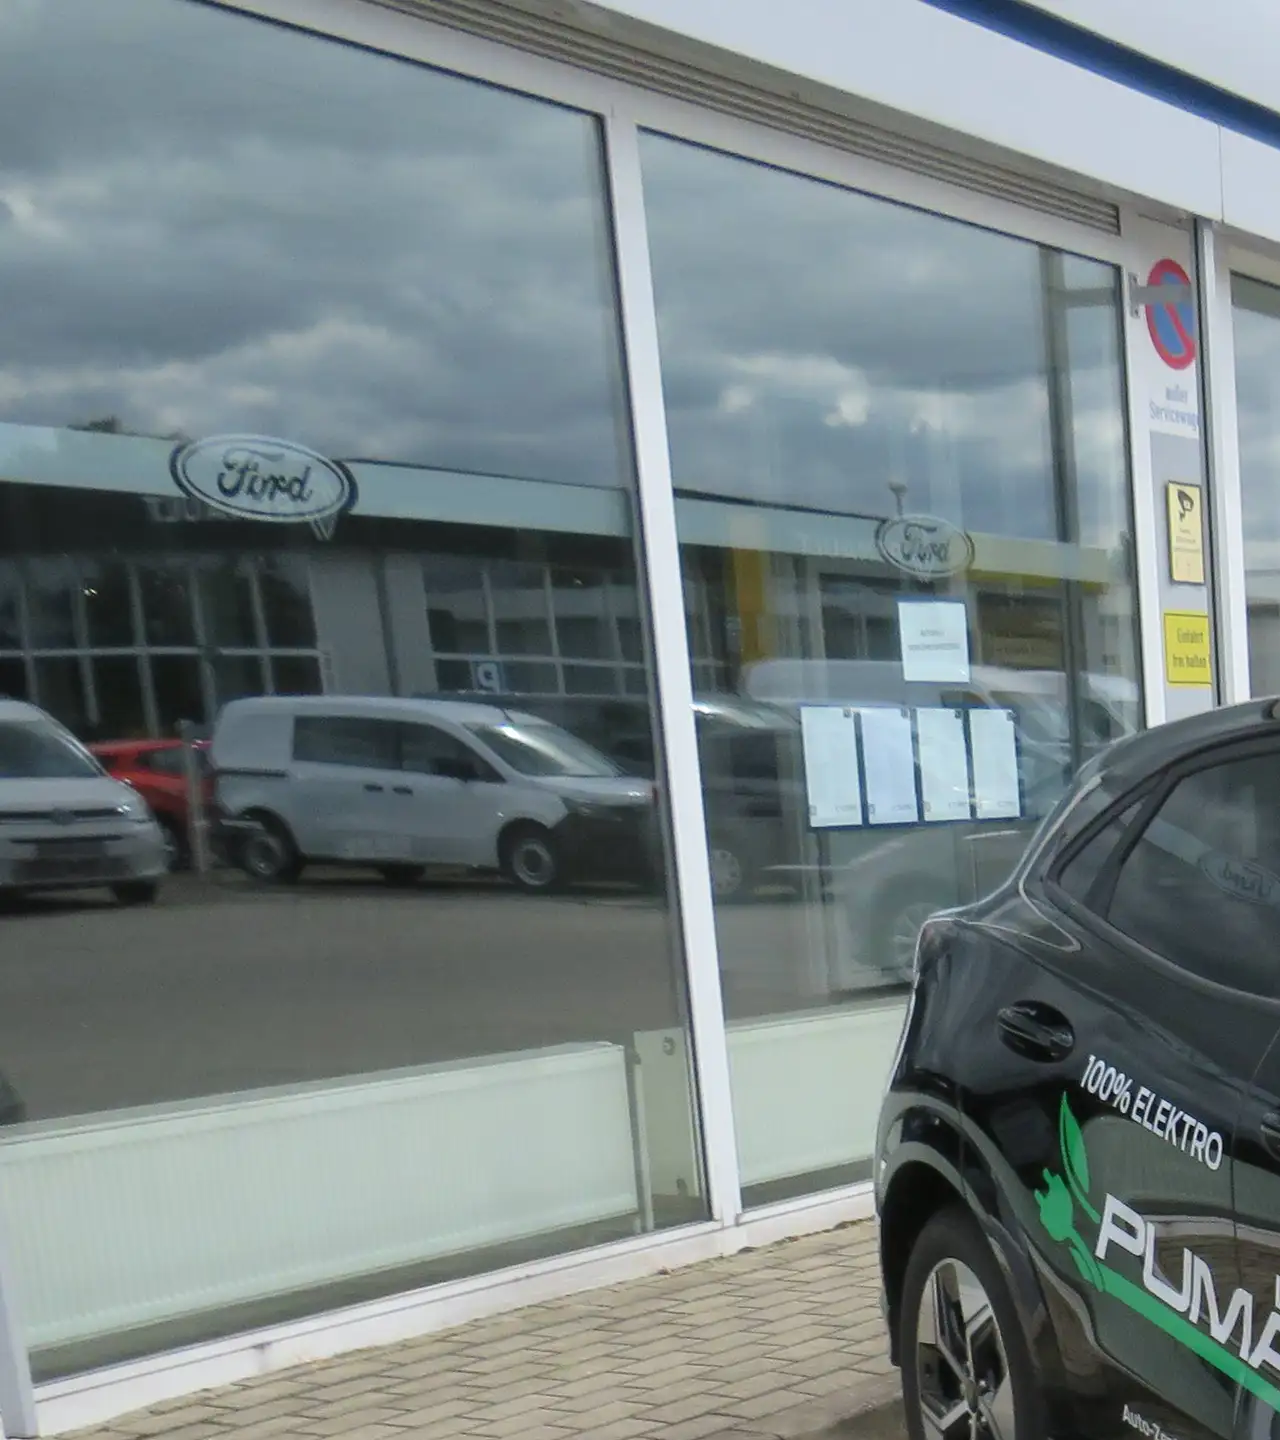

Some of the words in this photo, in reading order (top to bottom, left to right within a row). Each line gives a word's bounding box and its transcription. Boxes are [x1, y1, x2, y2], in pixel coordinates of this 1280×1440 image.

[217, 448, 313, 502] Ford
[1080, 1054, 1133, 1114] 100%
[1131, 1086, 1223, 1170] ELEKTRO
